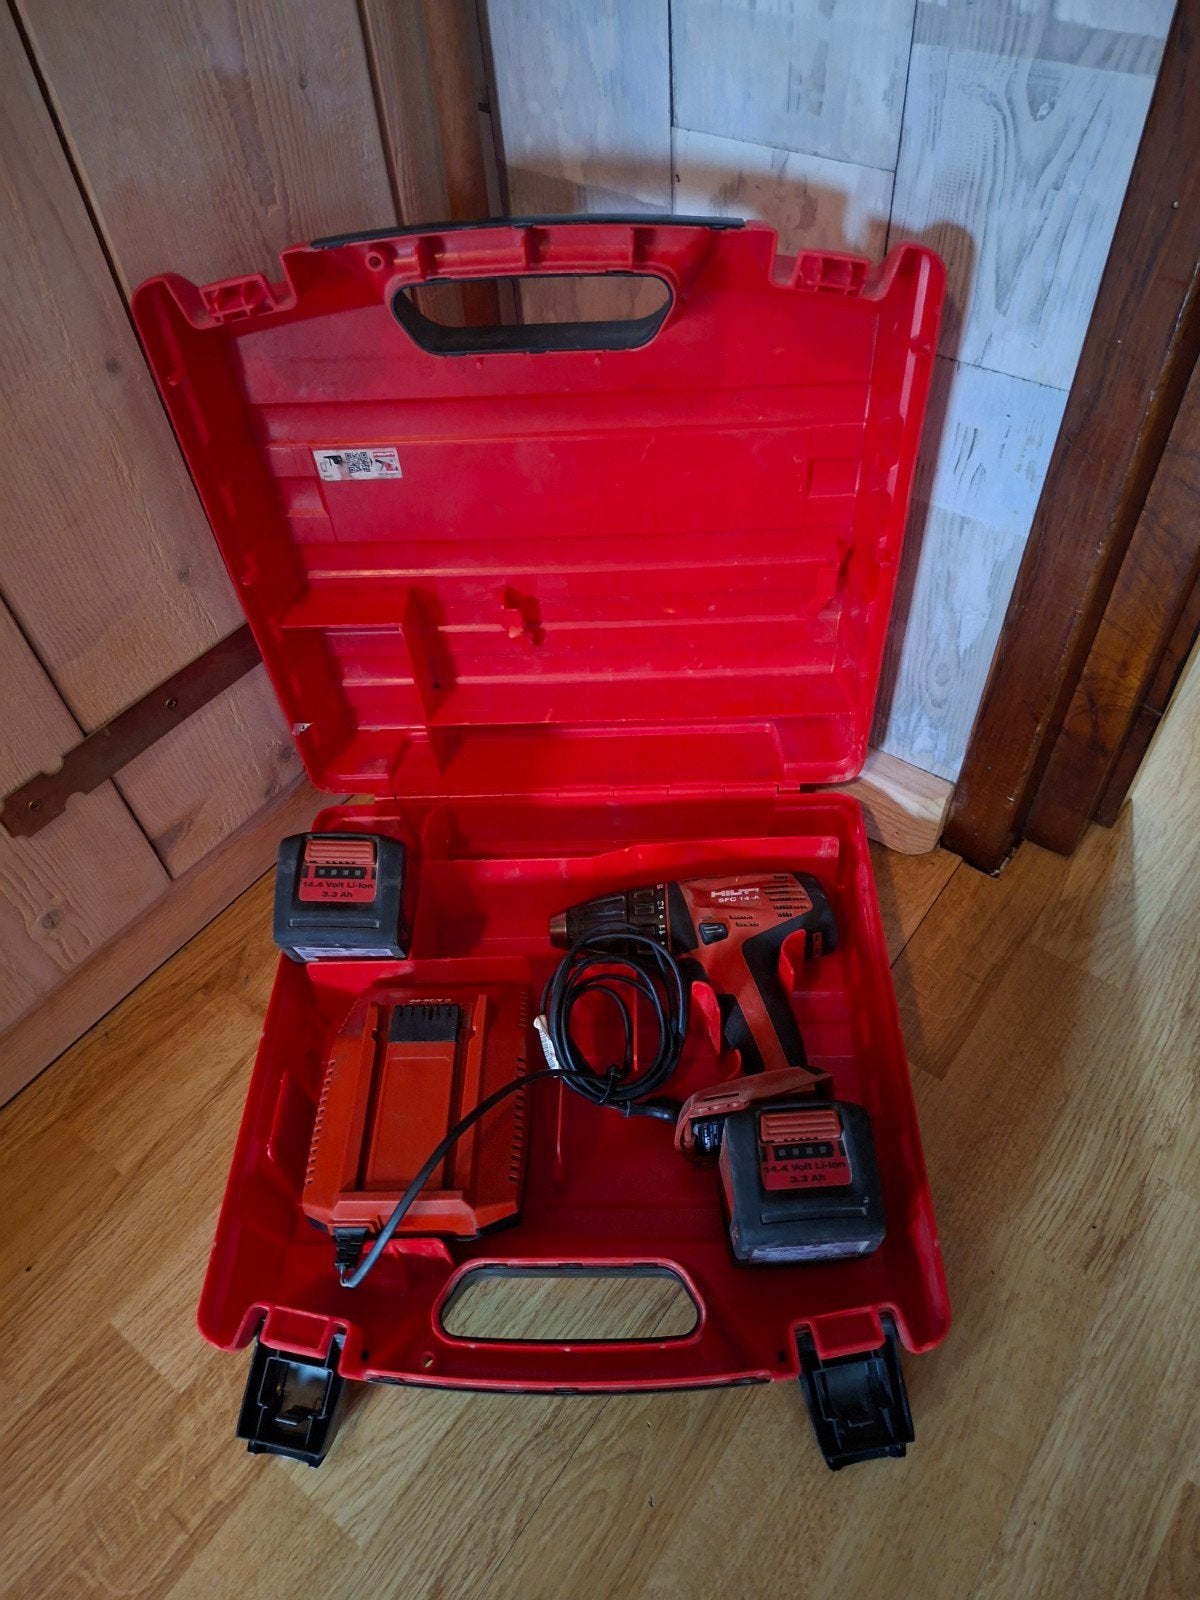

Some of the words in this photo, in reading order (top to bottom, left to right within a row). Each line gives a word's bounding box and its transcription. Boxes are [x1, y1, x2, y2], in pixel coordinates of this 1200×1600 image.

[711, 887, 760, 898] HILTI
[764, 1165, 788, 1173] 14.4
[791, 1163, 812, 1171] Volt
[789, 1175, 808, 1184] 3.3
[811, 1174, 826, 1182] Ah
